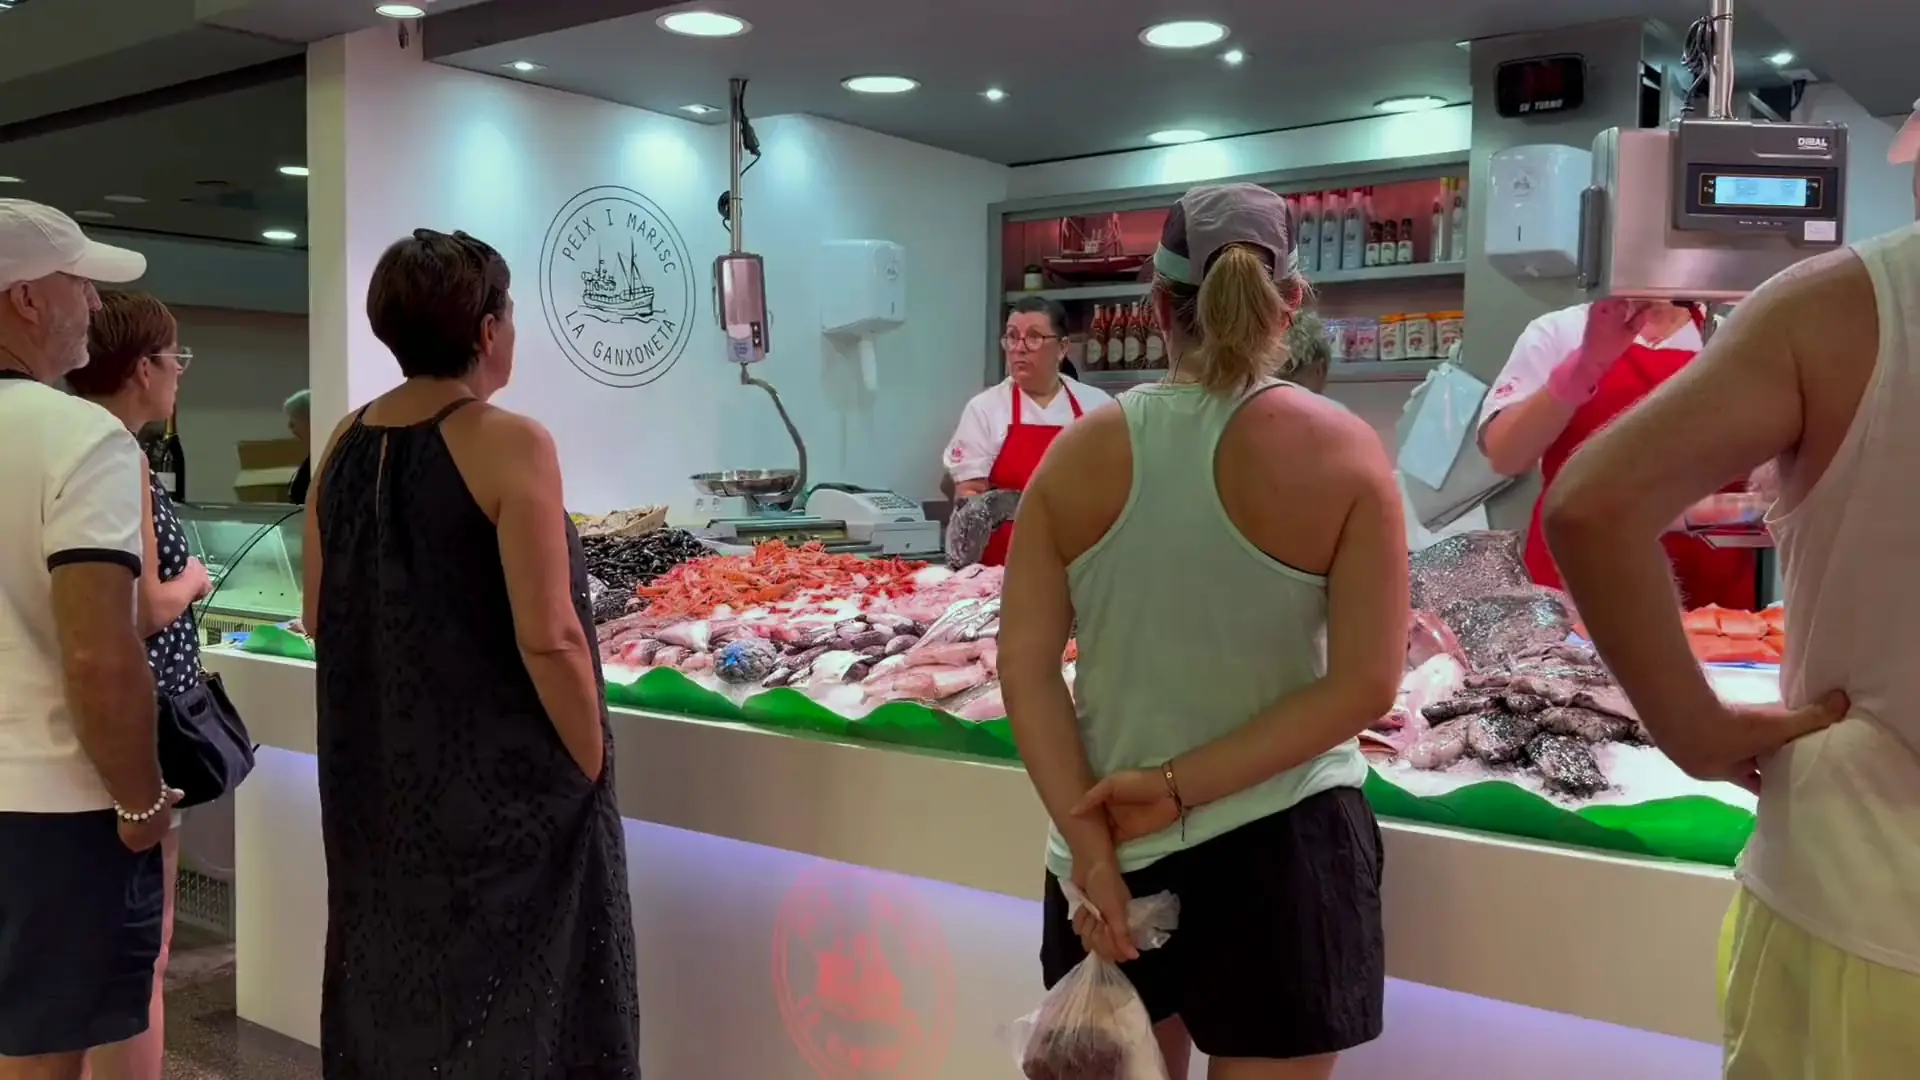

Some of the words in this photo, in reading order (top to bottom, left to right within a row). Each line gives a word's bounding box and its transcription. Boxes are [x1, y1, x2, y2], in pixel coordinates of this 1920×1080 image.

[562, 216, 596, 261] PEIX
[605, 208, 615, 226] I
[626, 212, 676, 273] MARISC
[565, 310, 586, 339] LA
[593, 318, 676, 367] GANXONETA
